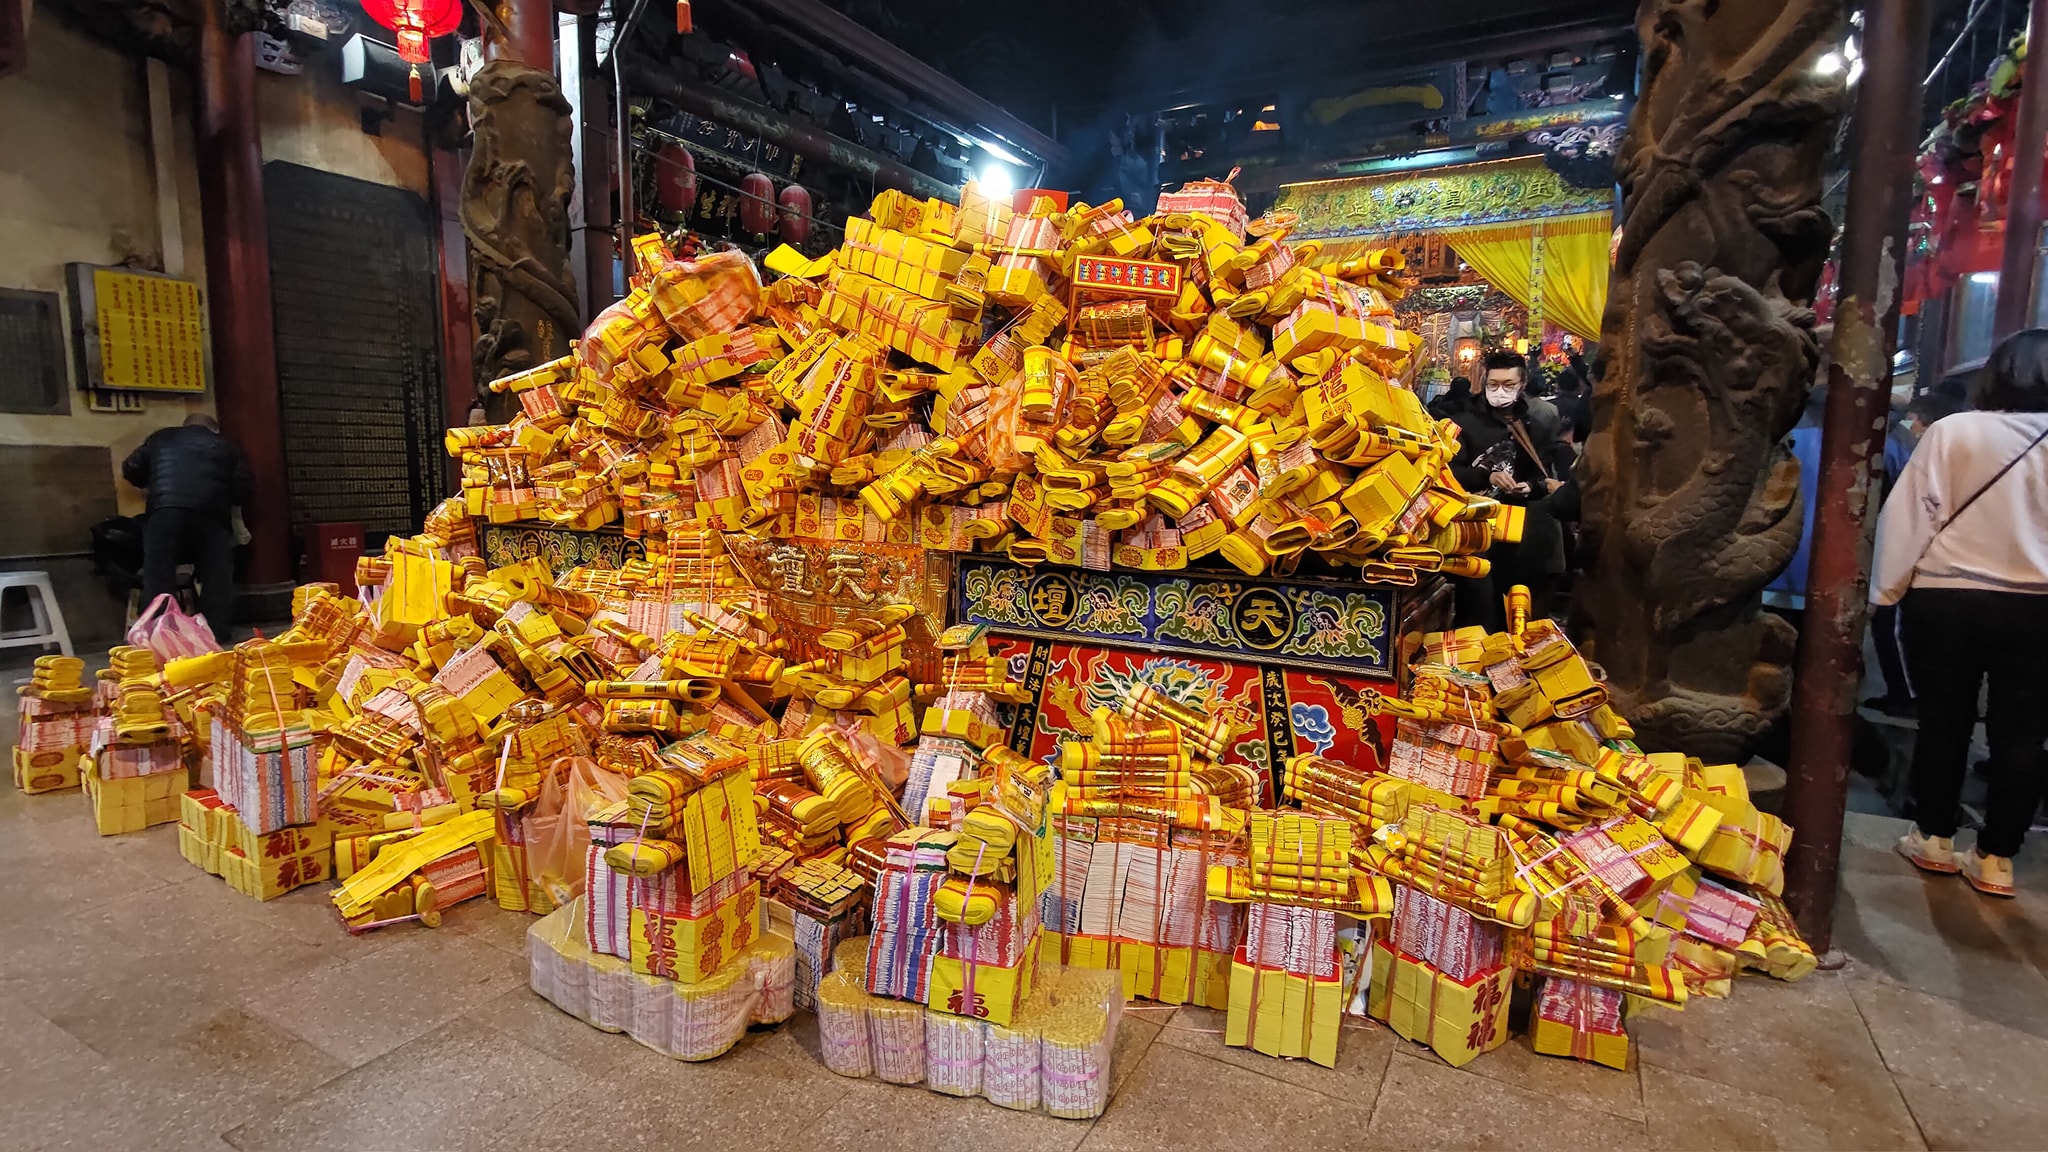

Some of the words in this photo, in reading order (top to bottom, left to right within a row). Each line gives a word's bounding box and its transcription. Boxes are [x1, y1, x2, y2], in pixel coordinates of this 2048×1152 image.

[1318, 374, 1348, 404] 福
[767, 546, 876, 603] 天壇
[1016, 645, 1049, 756] 財團法天壇董
[947, 989, 990, 1018] 福
[1472, 975, 1502, 1015] 福
